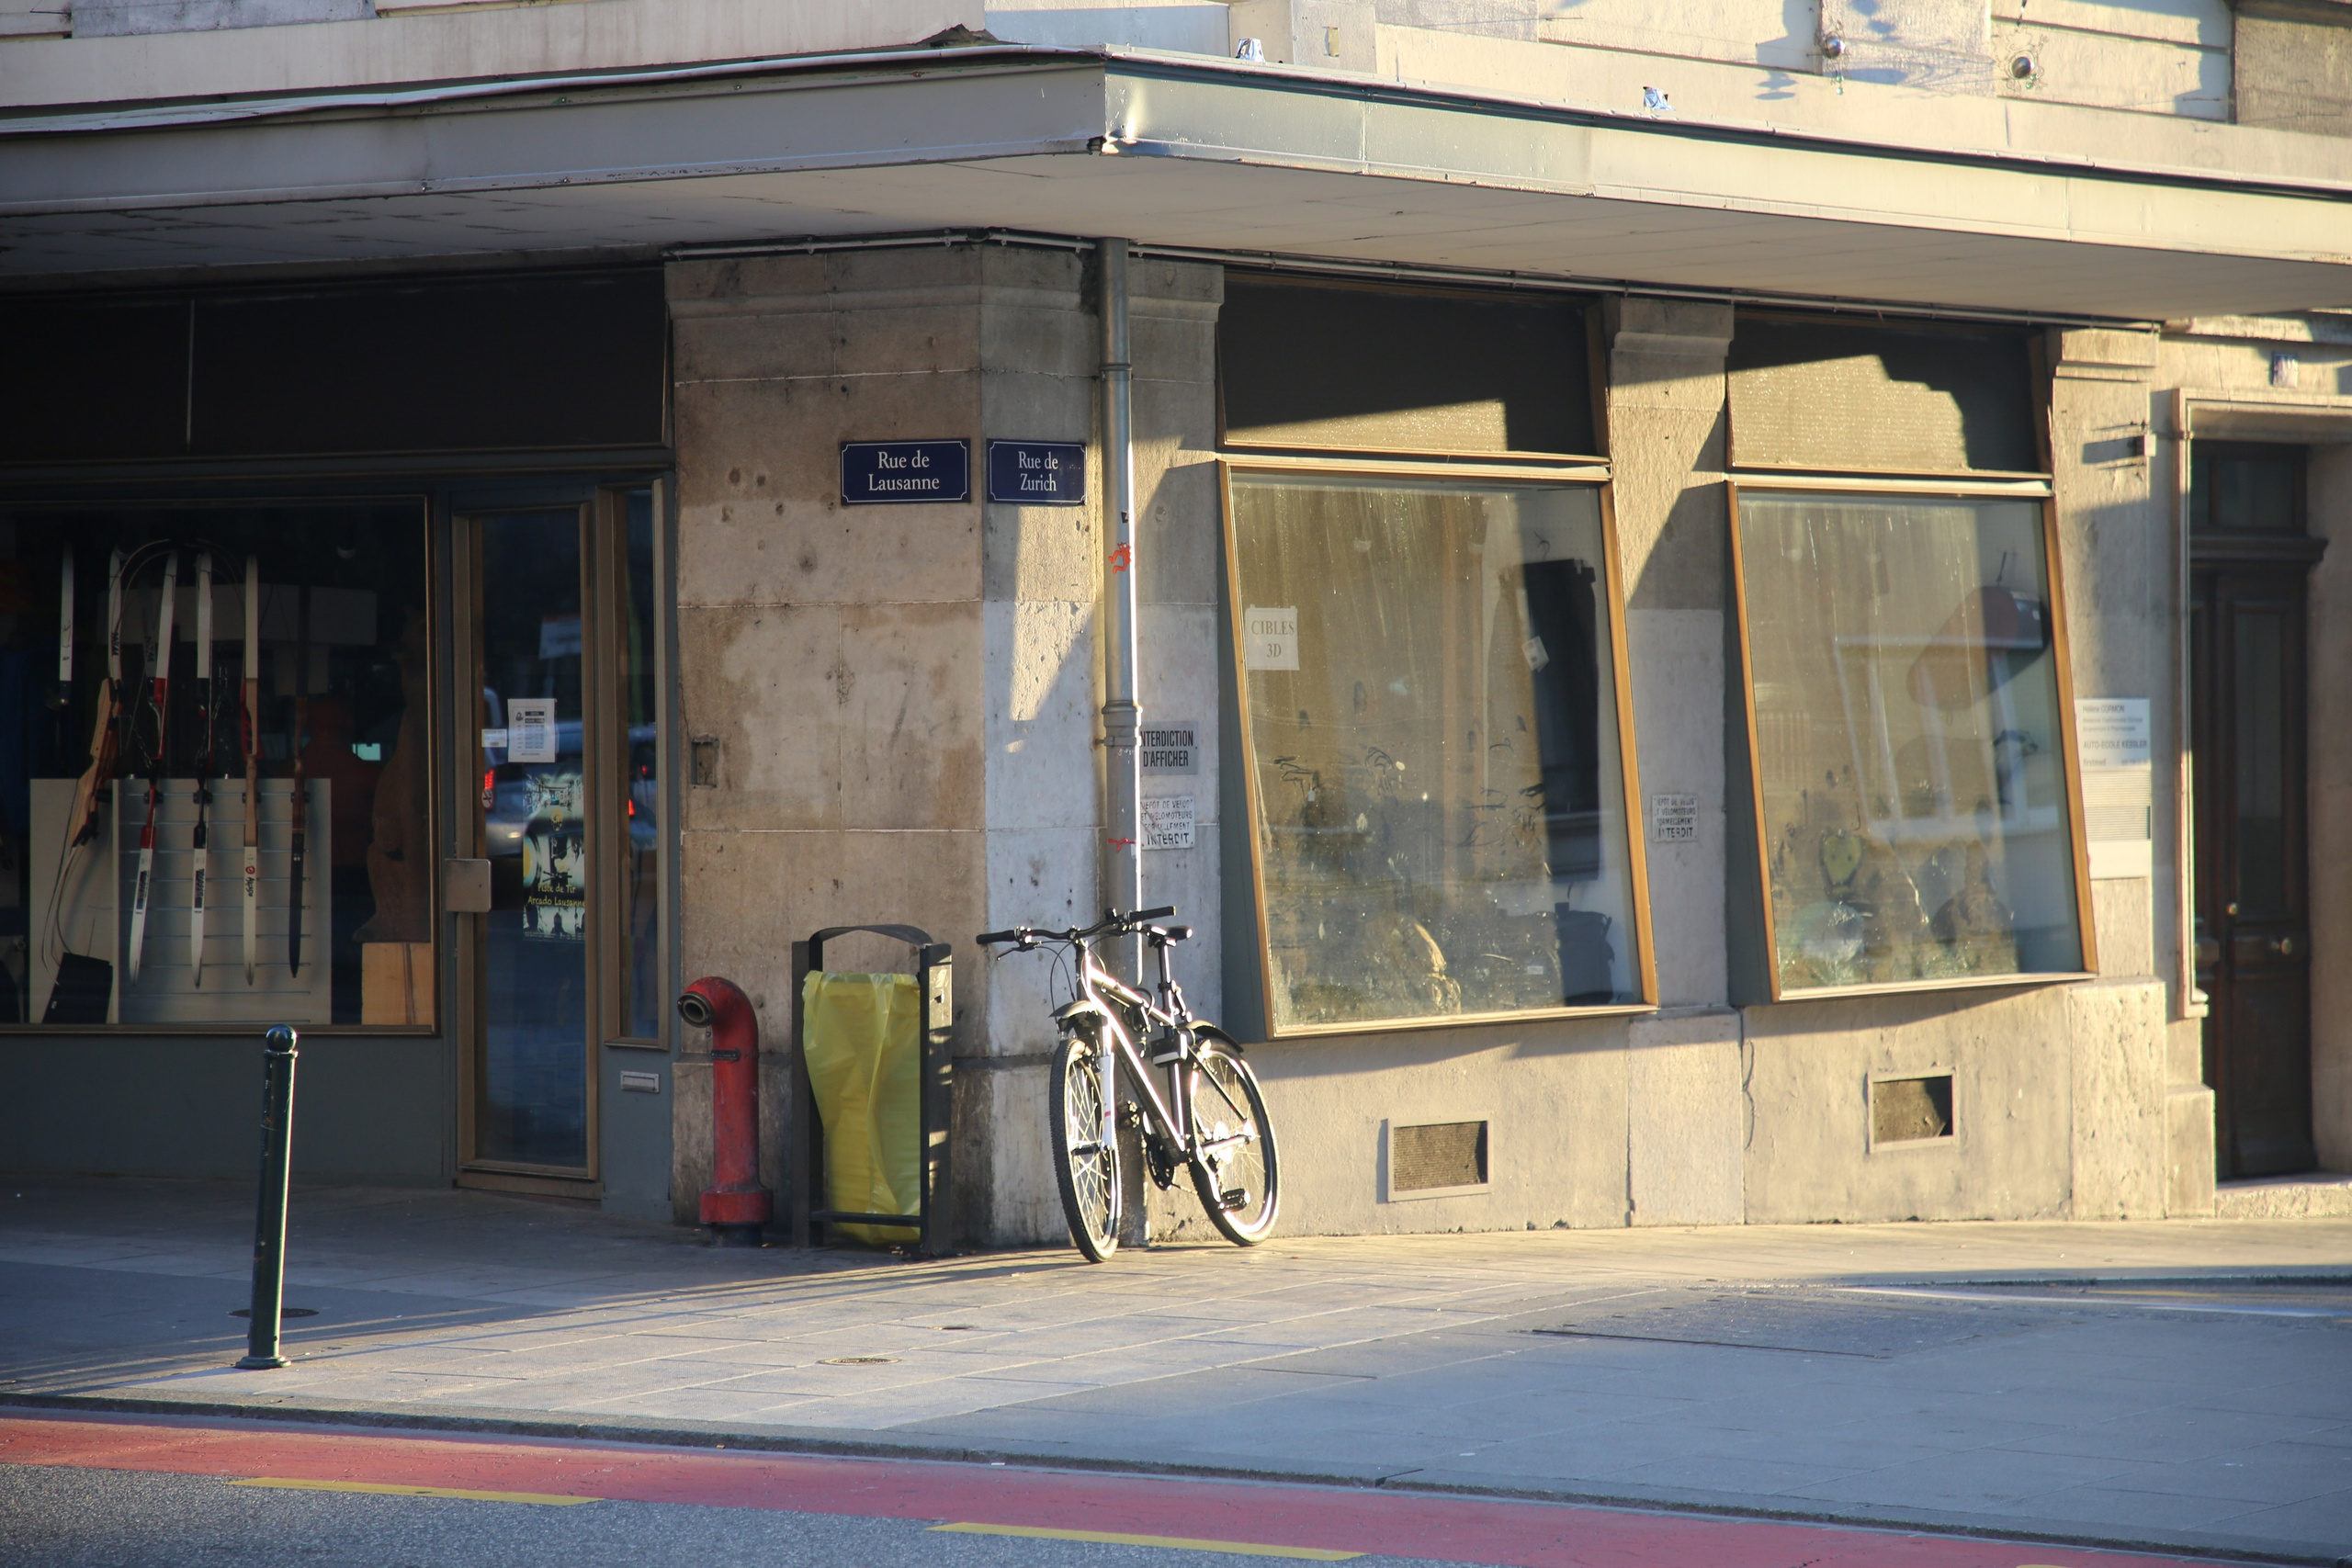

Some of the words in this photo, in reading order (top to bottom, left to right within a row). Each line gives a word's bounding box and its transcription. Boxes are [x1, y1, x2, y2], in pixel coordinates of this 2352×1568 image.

[877, 451, 907, 469] Rue
[911, 449, 930, 468] de
[1018, 451, 1041, 469] Rue
[1044, 452, 1058, 469] de
[868, 473, 940, 491] Lausanne
[1020, 473, 1057, 491] Zurich
[1251, 620, 1295, 635] CIBLES
[1266, 643, 1282, 658] 3D
[1140, 730, 1193, 747] NTERDICTION
[1143, 750, 1189, 767] D'AFFICHER
[555, 883, 564, 893] de
